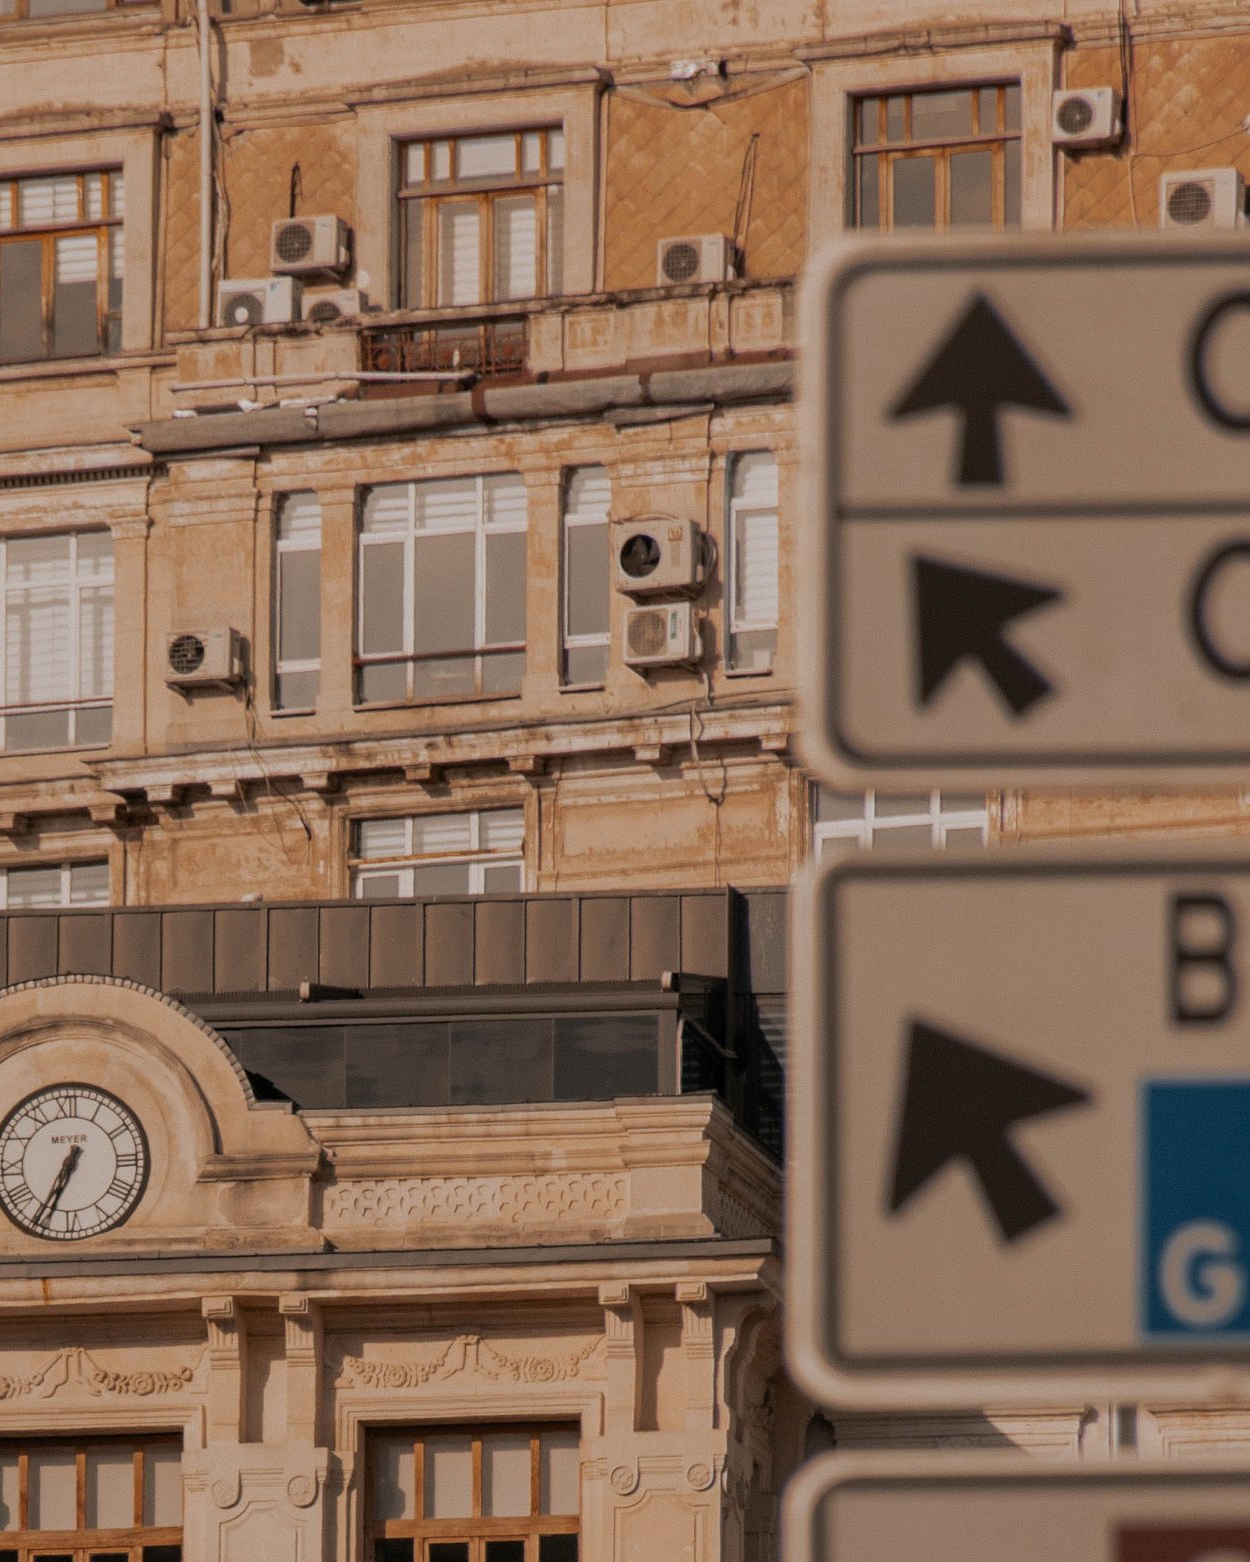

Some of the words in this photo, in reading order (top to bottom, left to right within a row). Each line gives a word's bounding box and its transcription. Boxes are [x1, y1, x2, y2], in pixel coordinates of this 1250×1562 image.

[1168, 888, 1241, 1028] B
[51, 1134, 87, 1145] MEYER
[1161, 1221, 1246, 1328] G
